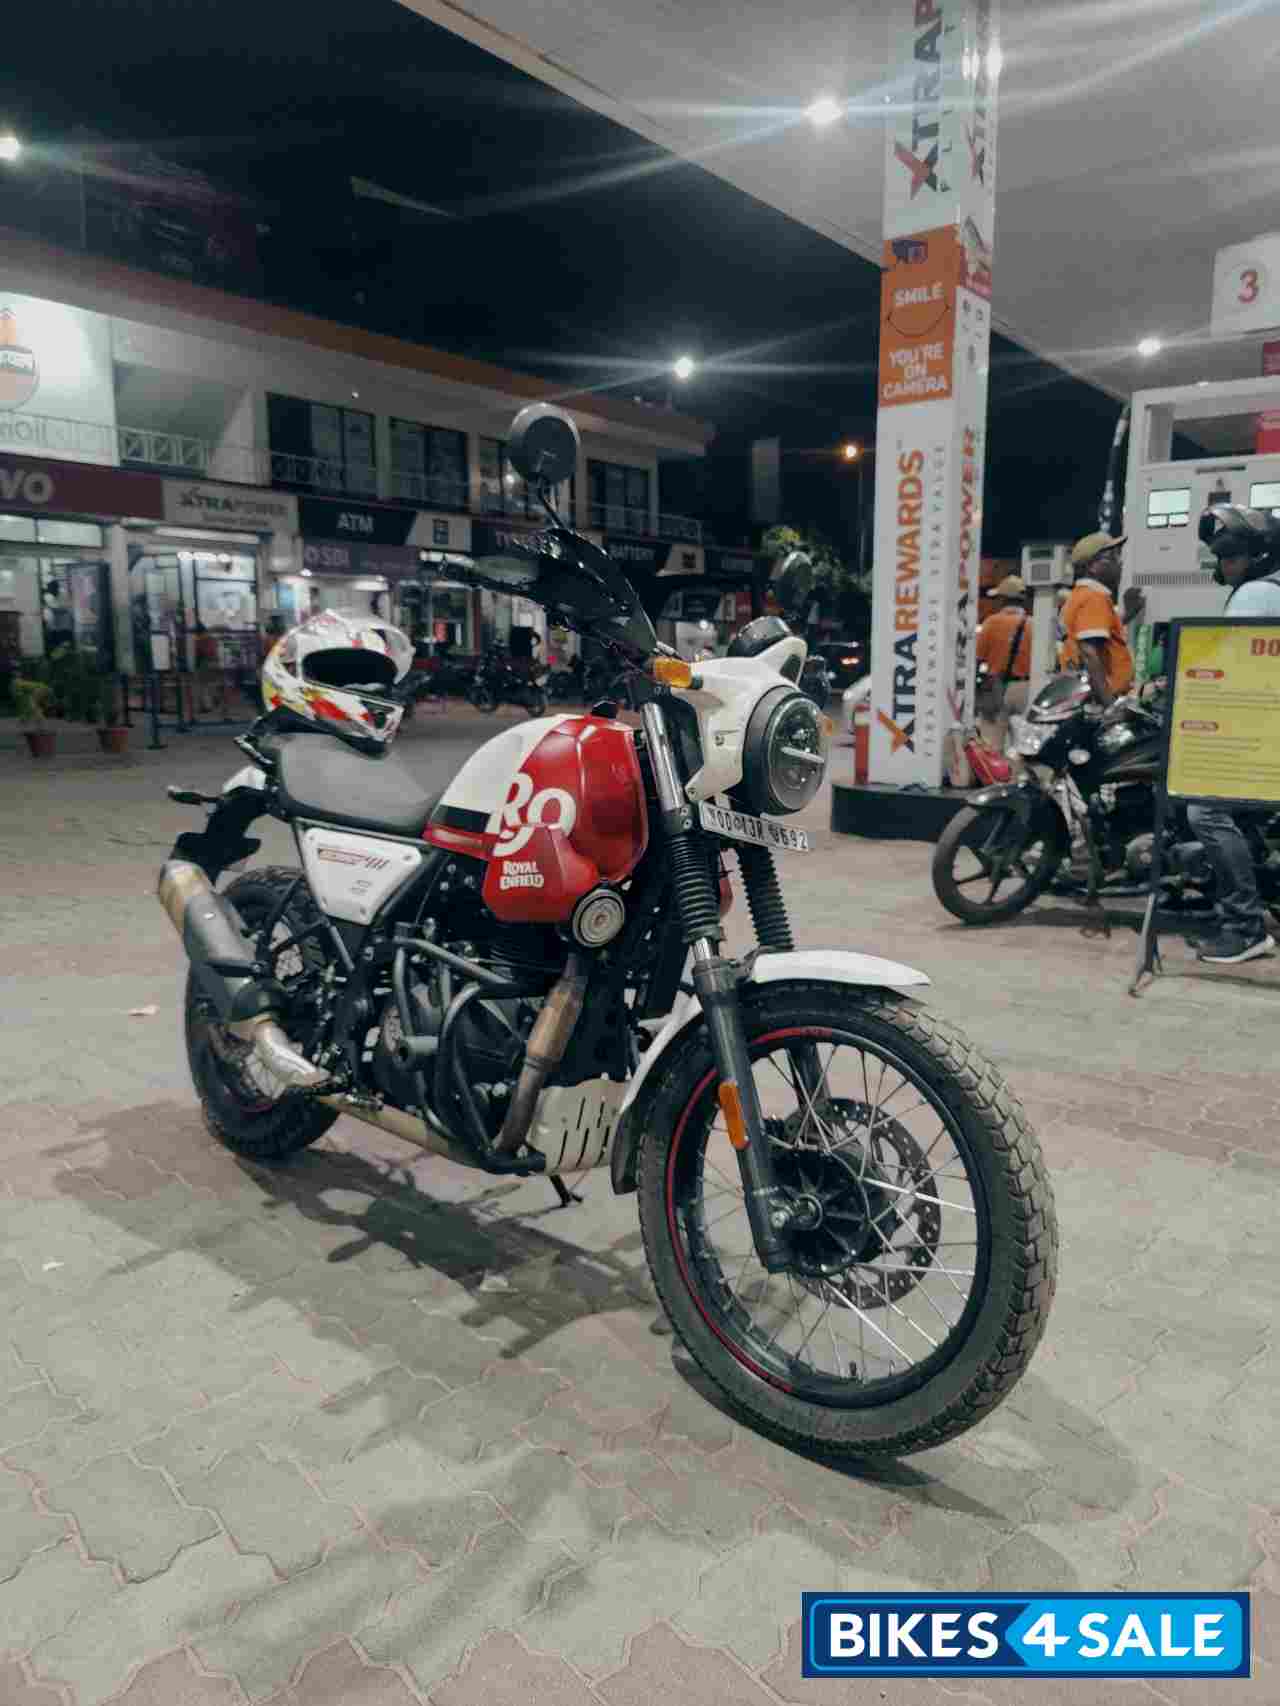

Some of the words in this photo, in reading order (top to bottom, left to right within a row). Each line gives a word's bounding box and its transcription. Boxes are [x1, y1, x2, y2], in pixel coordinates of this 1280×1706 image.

[895, 282, 945, 307] SMILE
[1238, 269, 1259, 302] 3
[337, 512, 375, 533] ATM
[503, 861, 539, 875] ROYAL
[500, 873, 545, 890] ENFIELD
